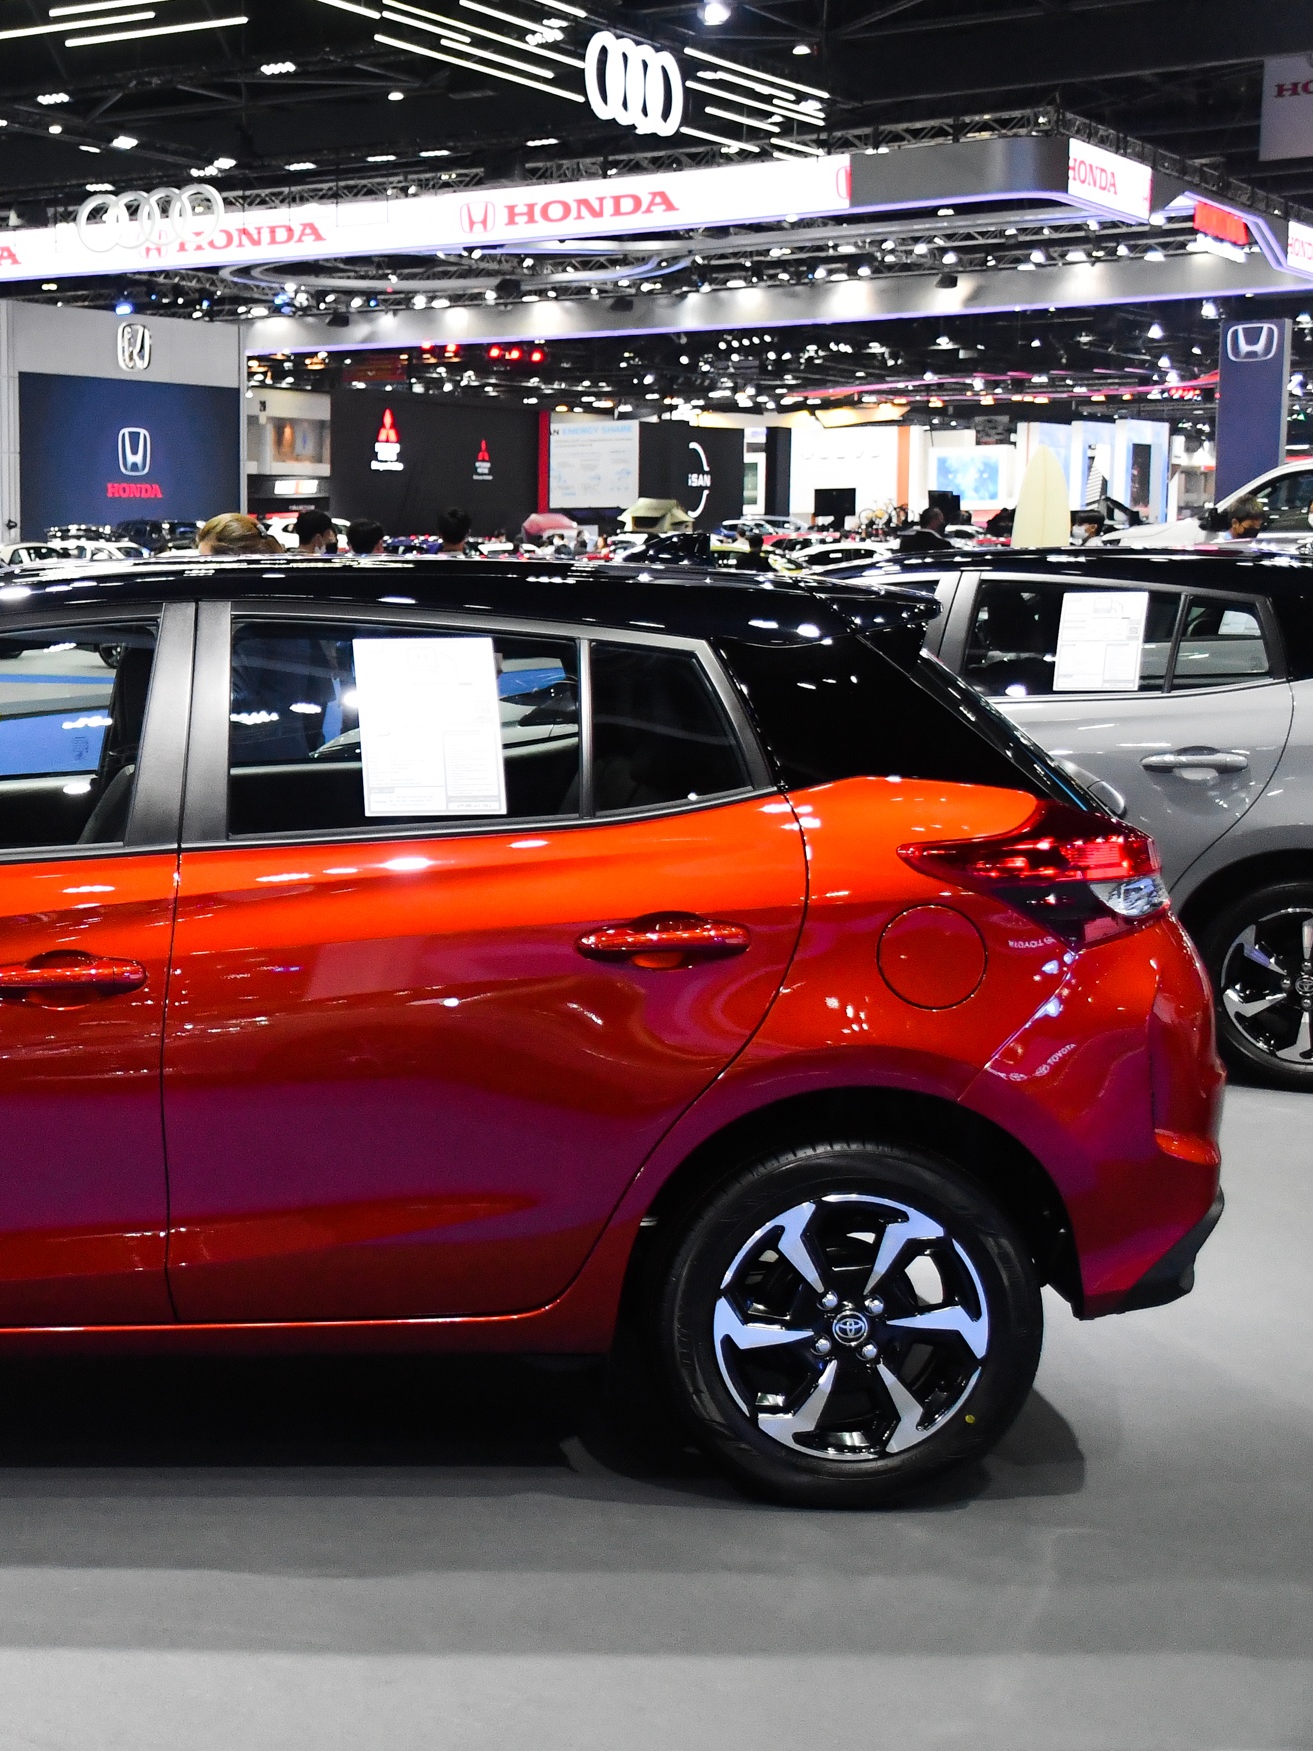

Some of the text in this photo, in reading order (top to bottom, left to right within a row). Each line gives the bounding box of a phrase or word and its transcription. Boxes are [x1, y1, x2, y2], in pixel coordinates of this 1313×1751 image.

[1069, 157, 1118, 196] HONDA
[503, 190, 680, 227] HONDA
[106, 482, 164, 499] HONDA
